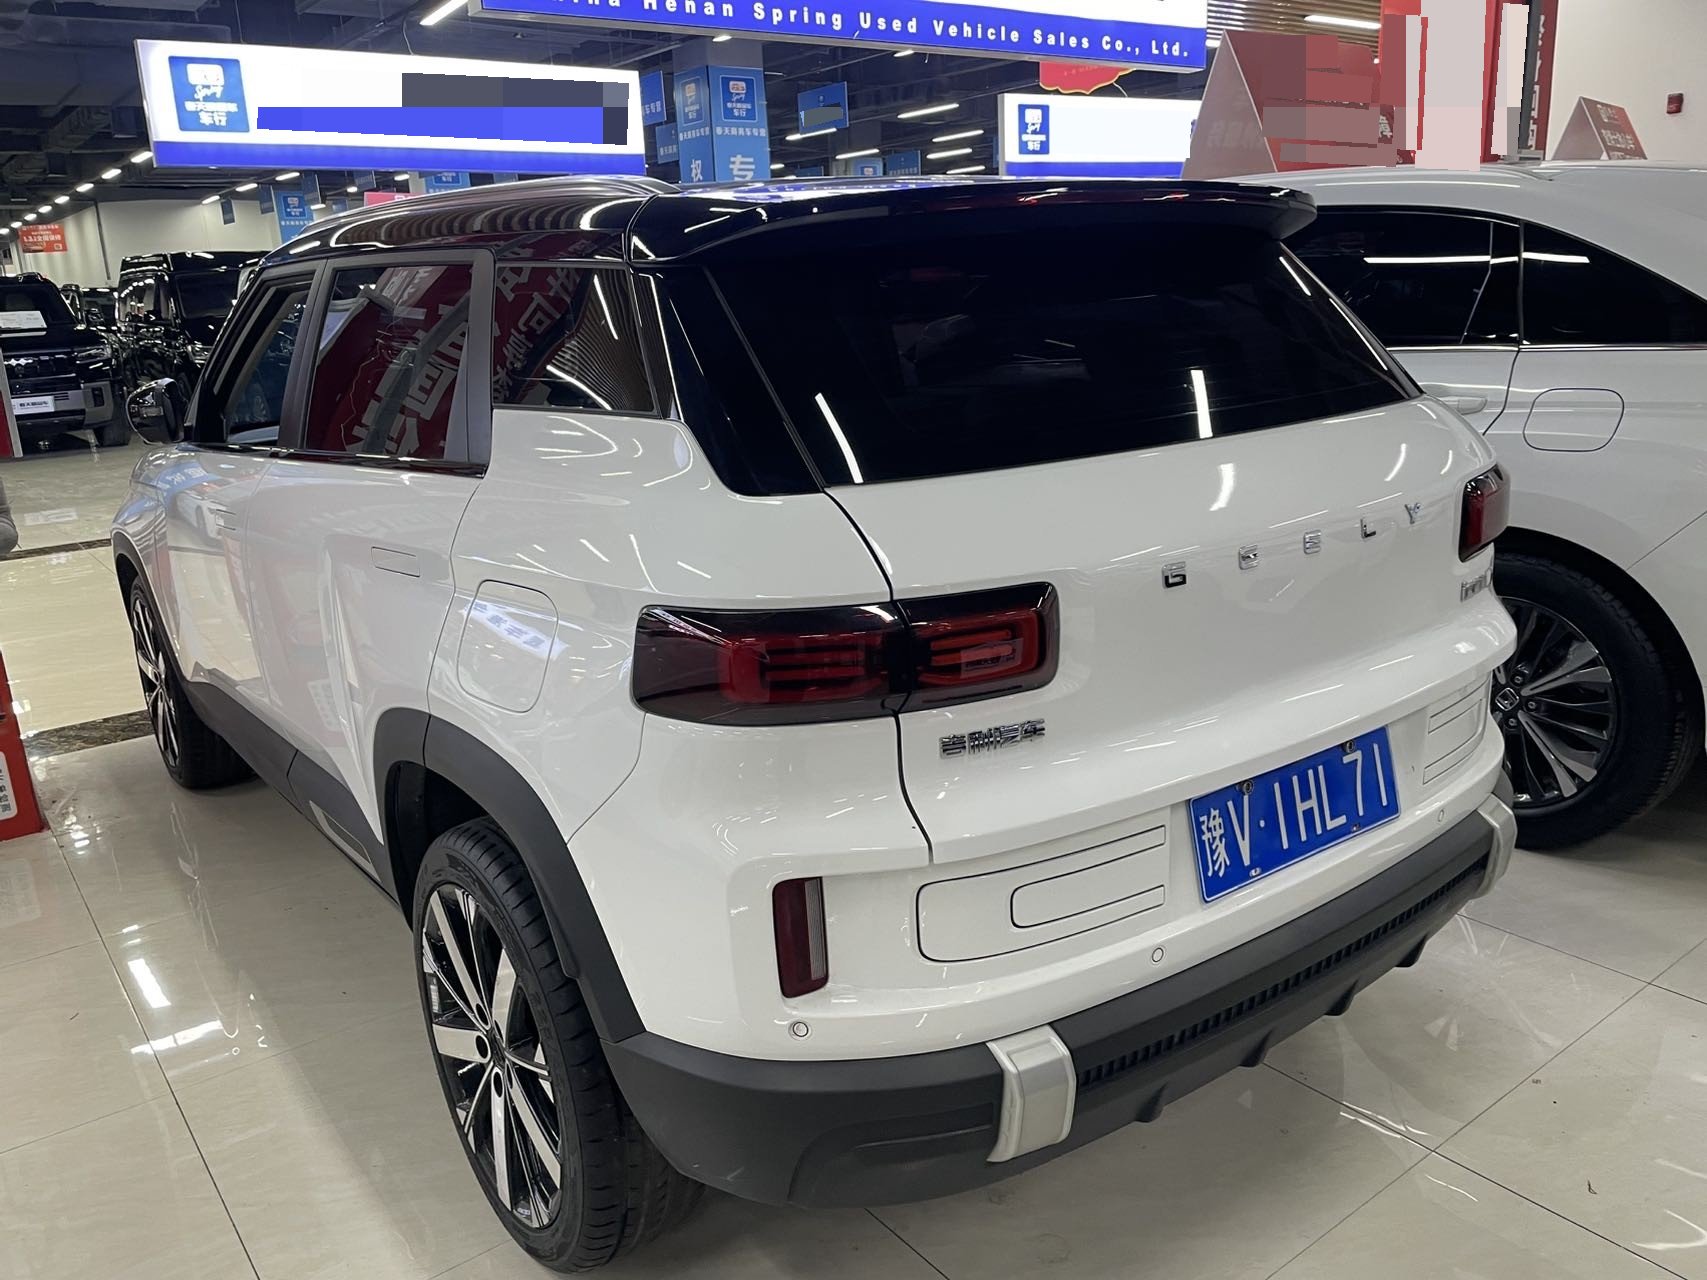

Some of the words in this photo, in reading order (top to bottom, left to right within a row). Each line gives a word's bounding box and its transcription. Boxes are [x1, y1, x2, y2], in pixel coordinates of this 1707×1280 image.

[643, 0, 734, 17] Henan
[753, 2, 842, 31] Spring
[859, 11, 917, 33] Used
[932, 19, 1019, 43] Vehicle
[1033, 29, 1090, 49] Sales
[1151, 39, 1188, 57] Ltd.
[1161, 501, 1422, 590] GEELY
[940, 718, 1046, 759] 吉利汽车
